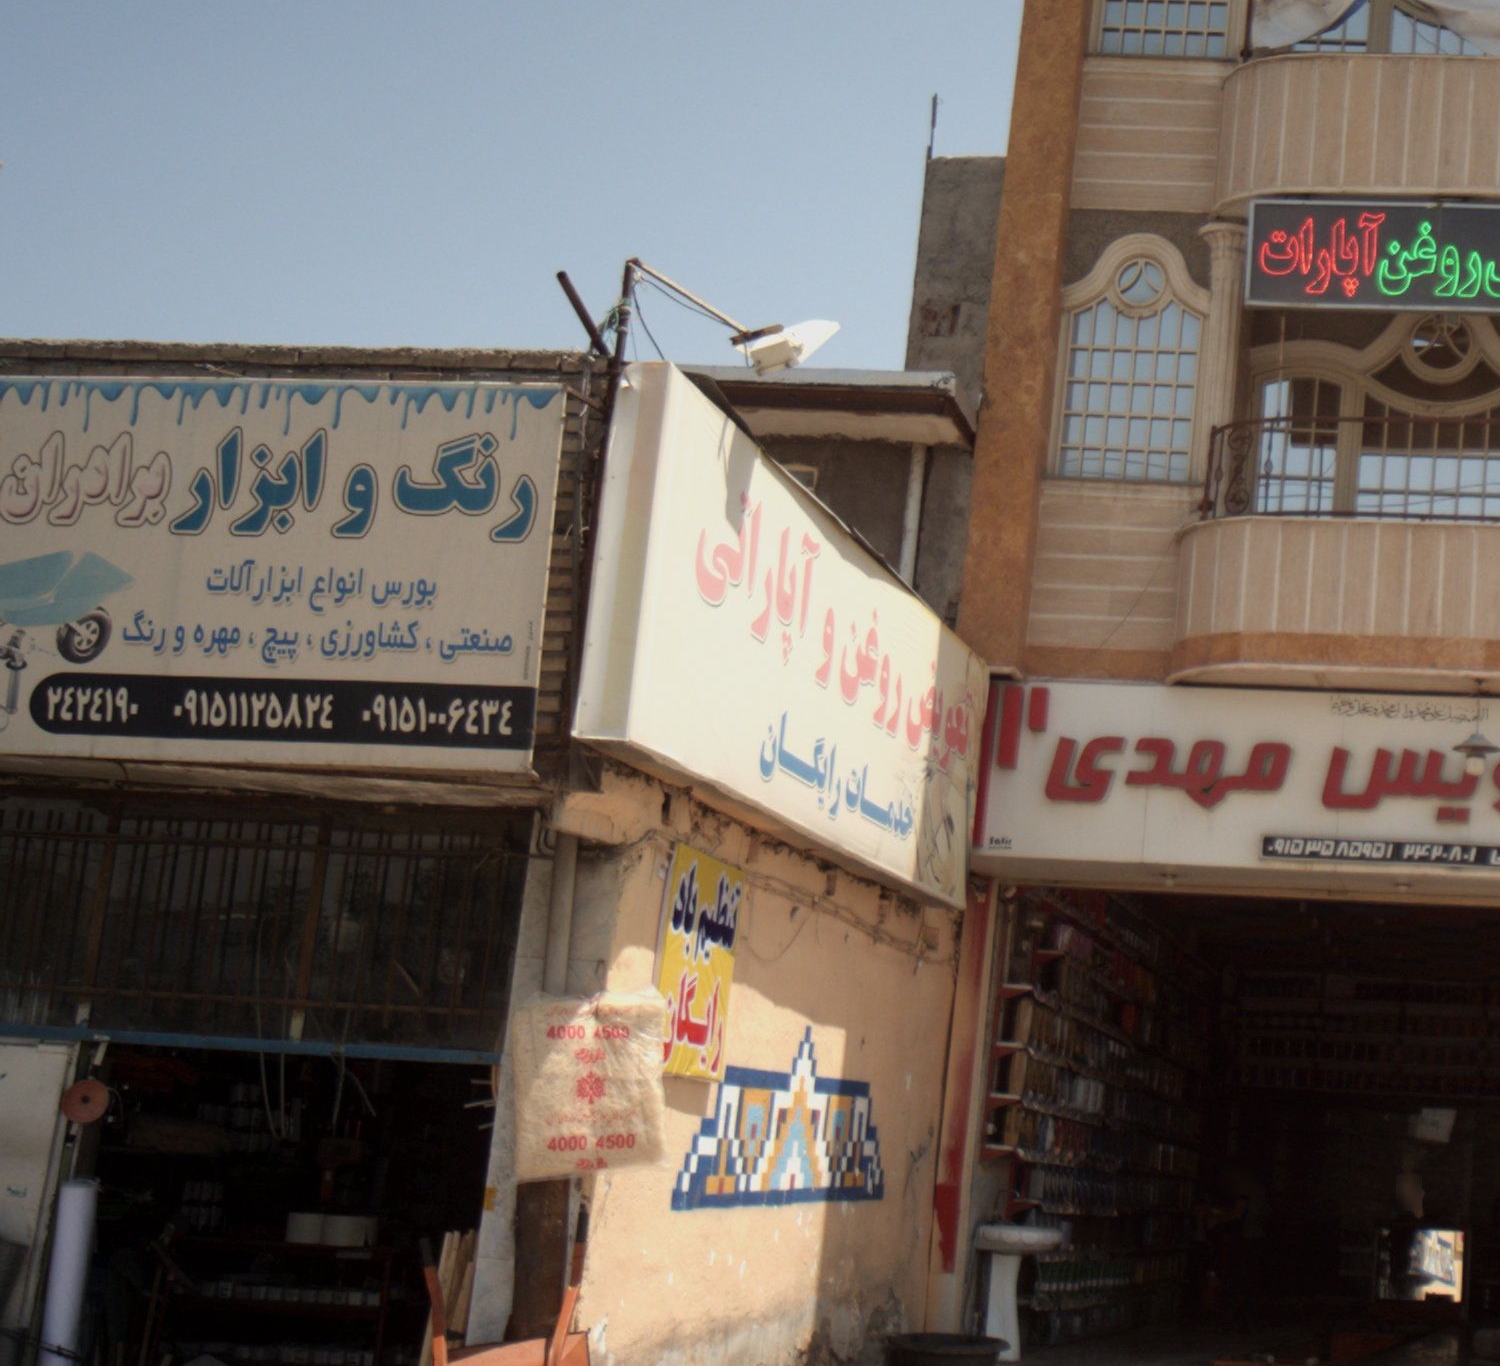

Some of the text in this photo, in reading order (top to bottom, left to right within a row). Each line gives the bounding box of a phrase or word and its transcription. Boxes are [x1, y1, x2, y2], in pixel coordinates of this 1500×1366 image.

[1259, 212, 1386, 298] آپارات
[1377, 220, 1483, 298] روغن
[0, 425, 538, 543] رنگ و ابزار برادران
[309, 566, 364, 612] انواع
[371, 572, 438, 606] بورس
[121, 609, 167, 653] رنگ
[173, 624, 185, 653] و
[194, 621, 241, 654] مهره
[260, 625, 298, 663] پیچ
[320, 619, 419, 658] کشاورزی
[439, 621, 513, 660] صنعتی
[815, 606, 835, 686] و
[839, 607, 902, 736] روغن
[905, 659, 973, 772] تعویض
[760, 711, 842, 818] رایگان
[1044, 735, 1292, 811] مهدی
[672, 863, 742, 960] تنظیم باد
[546, 1025, 631, 1040] 4000 4500
[547, 1134, 636, 1152] 4000 4500
